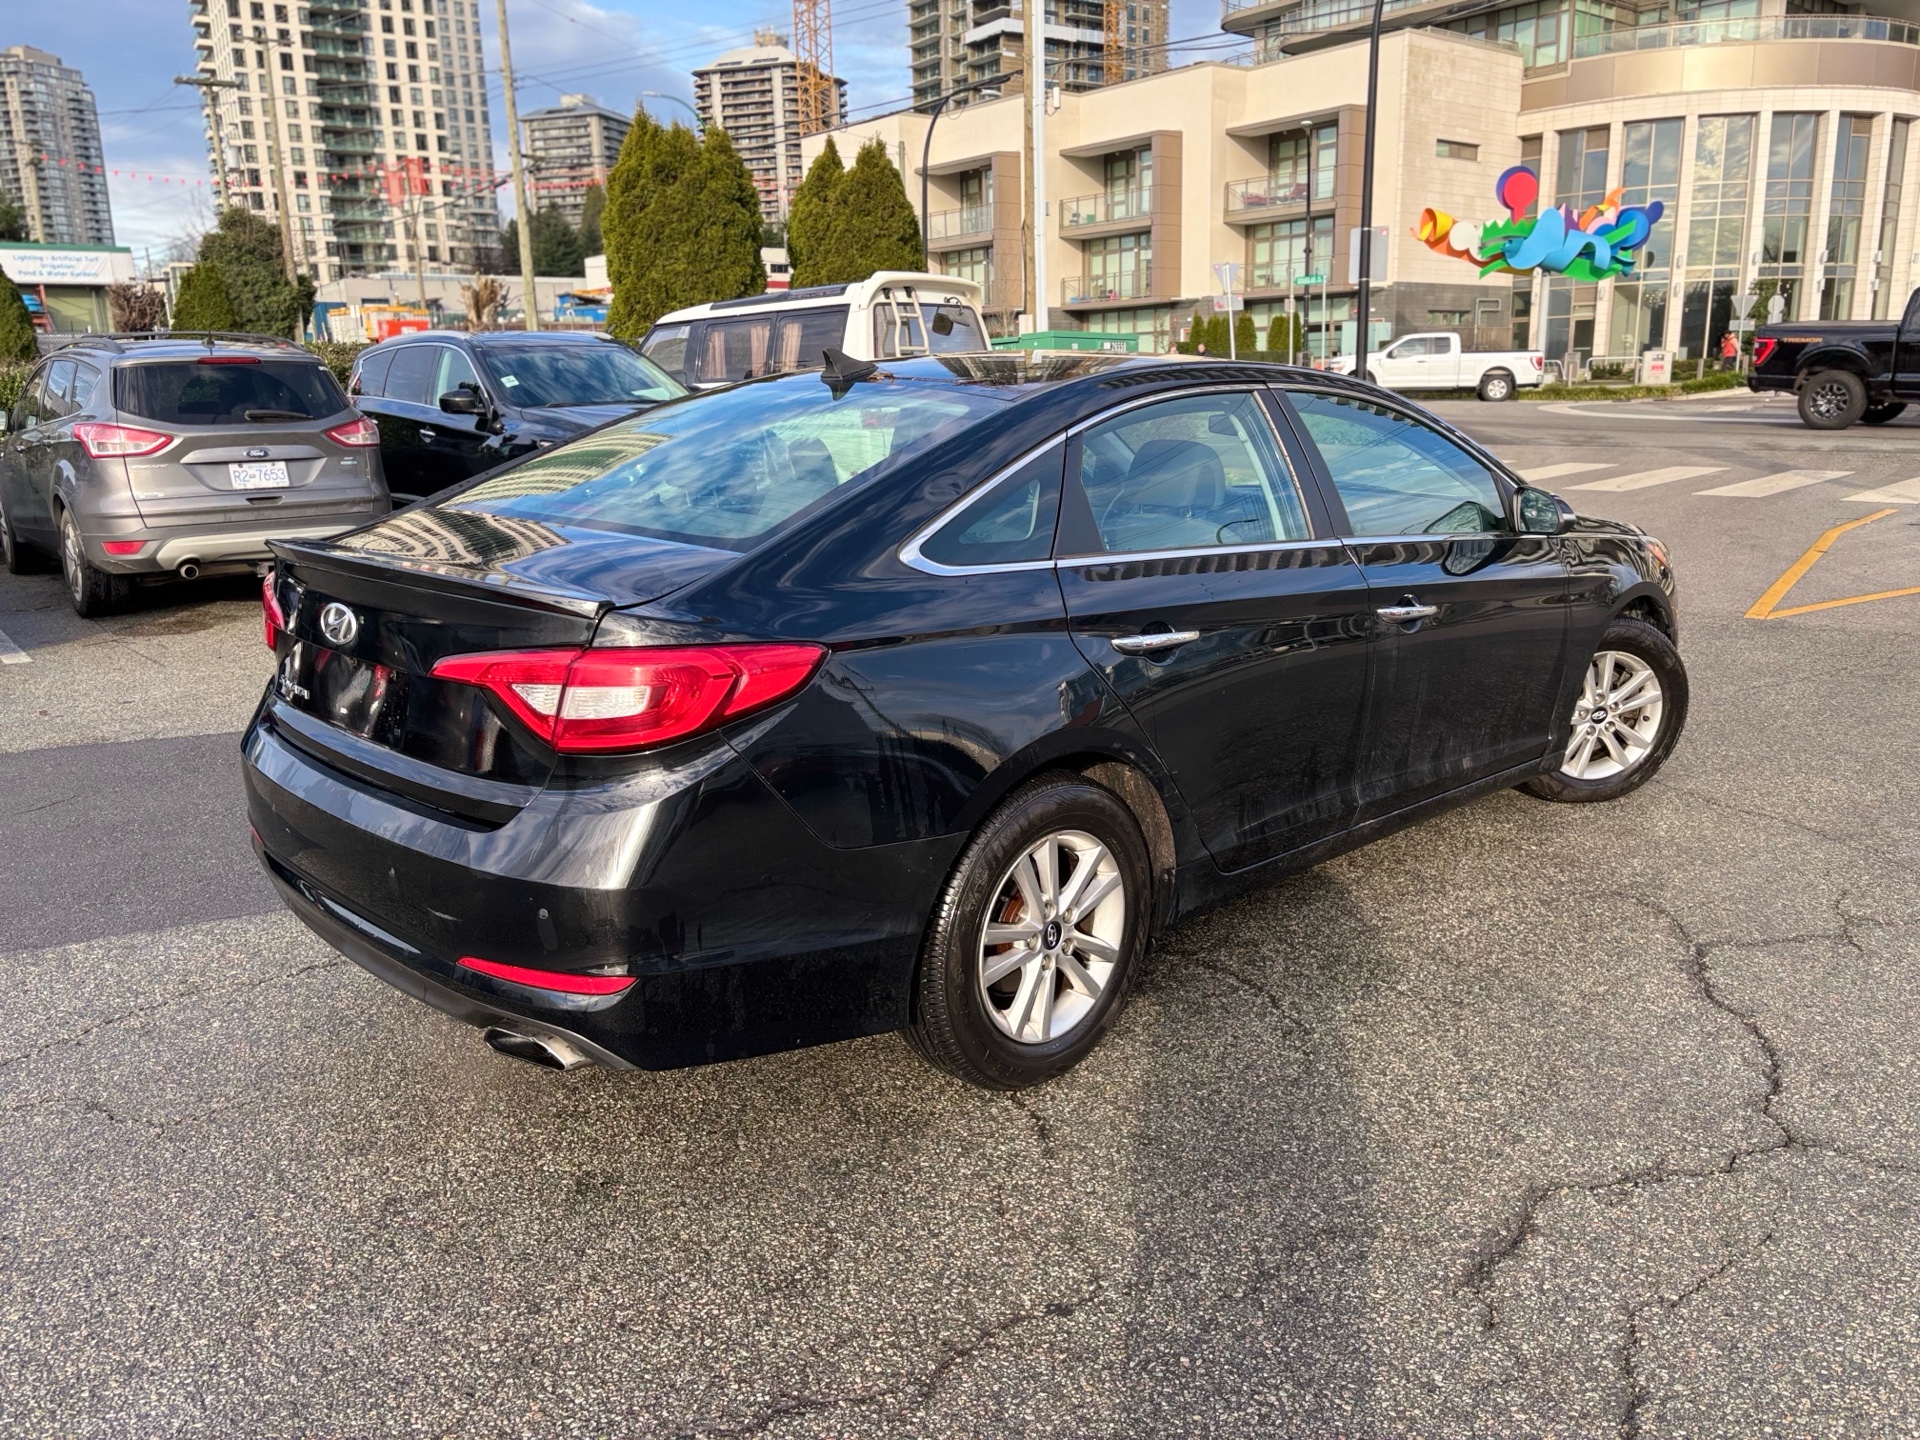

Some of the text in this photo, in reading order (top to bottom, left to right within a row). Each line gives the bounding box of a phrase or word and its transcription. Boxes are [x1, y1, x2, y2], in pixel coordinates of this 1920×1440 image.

[13, 254, 43, 262] Lighting
[40, 262, 75, 270] Irrigation
[249, 449, 265, 457] Ford
